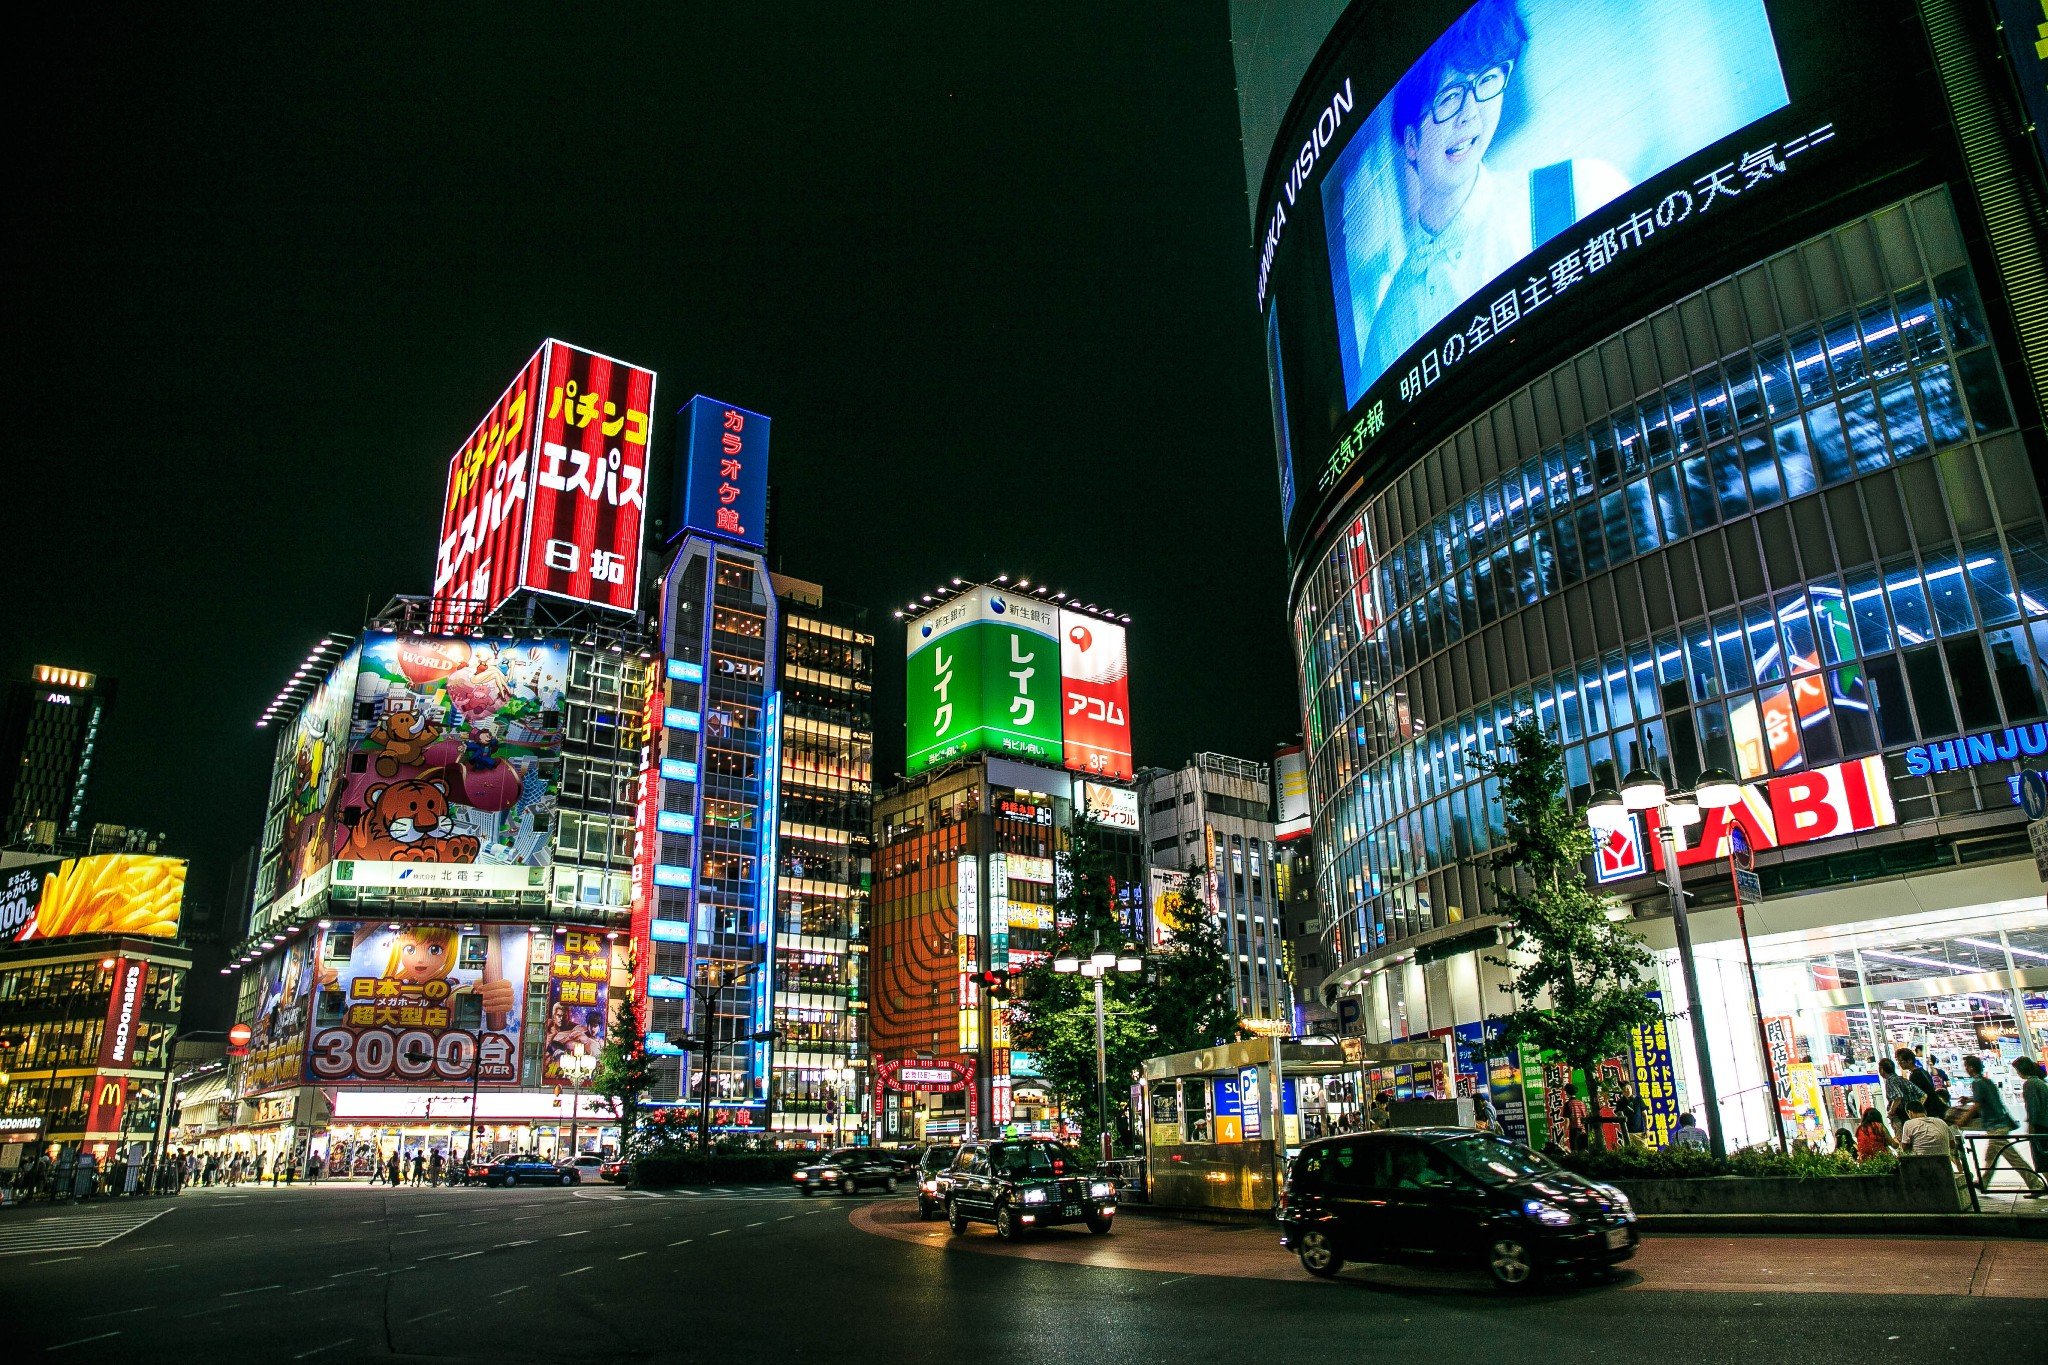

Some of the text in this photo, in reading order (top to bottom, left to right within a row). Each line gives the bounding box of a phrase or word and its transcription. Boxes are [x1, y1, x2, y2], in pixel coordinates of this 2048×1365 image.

[1285, 77, 1354, 206] VISION
[548, 380, 649, 446] パチンコ
[450, 389, 528, 512] パチンコ
[538, 442, 642, 511] エスパス
[433, 448, 528, 594] エスパス
[544, 539, 625, 585] 日拓
[1009, 603, 1051, 626] 新生銀行
[402, 650, 453, 671] WORLD
[933, 646, 953, 737] レイク
[1009, 633, 1035, 726] レイク
[1067, 692, 1125, 726] アコム
[1003, 737, 1044, 756] 当ビル向い
[1904, 722, 2048, 777] SHINJU
[1090, 753, 1108, 771] 3F
[1102, 809, 1136, 826] アイフル
[441, 870, 485, 882] 北電子
[565, 932, 601, 954] 日本
[553, 955, 608, 979] 最大級
[354, 978, 449, 998] 日本一の
[560, 980, 597, 1004] 設置
[112, 965, 140, 1062] McDonald's
[377, 998, 429, 1007] メガホール
[351, 1006, 449, 1027] 超大型店
[0, 1117, 42, 1130] cDonald's
[1224, 1122, 1235, 1139] 4
